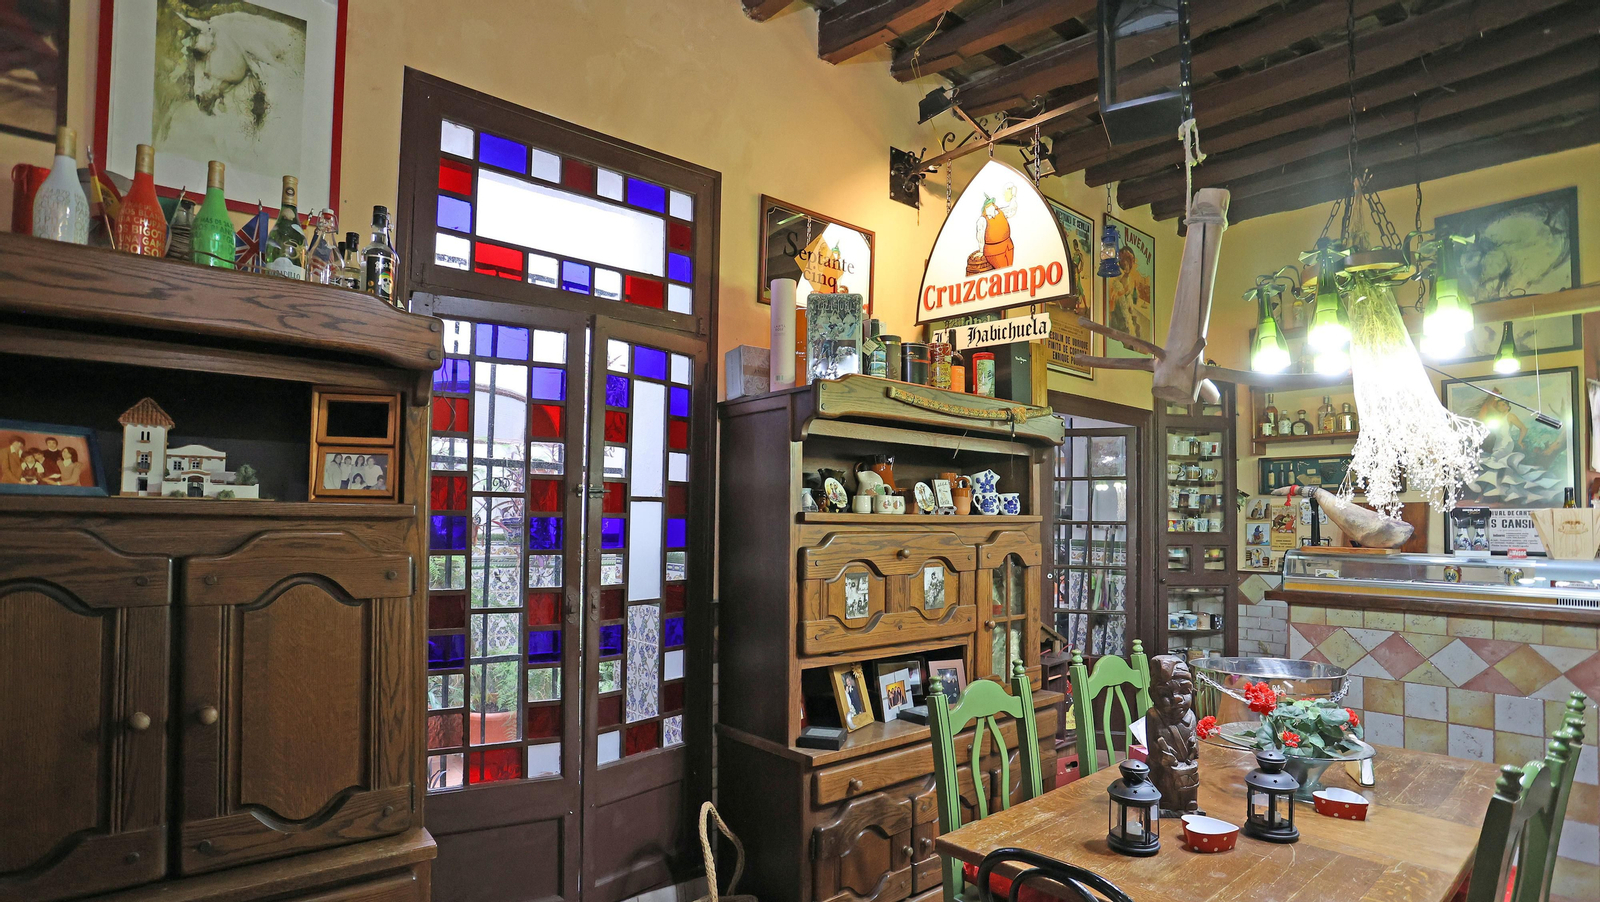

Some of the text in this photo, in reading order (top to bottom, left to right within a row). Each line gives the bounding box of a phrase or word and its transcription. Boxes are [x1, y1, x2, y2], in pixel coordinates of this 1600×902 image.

[783, 231, 855, 275] Septante
[803, 269, 838, 294] cinq
[923, 261, 1064, 311] Cruzcampo
[967, 318, 1047, 347] Habichuela
